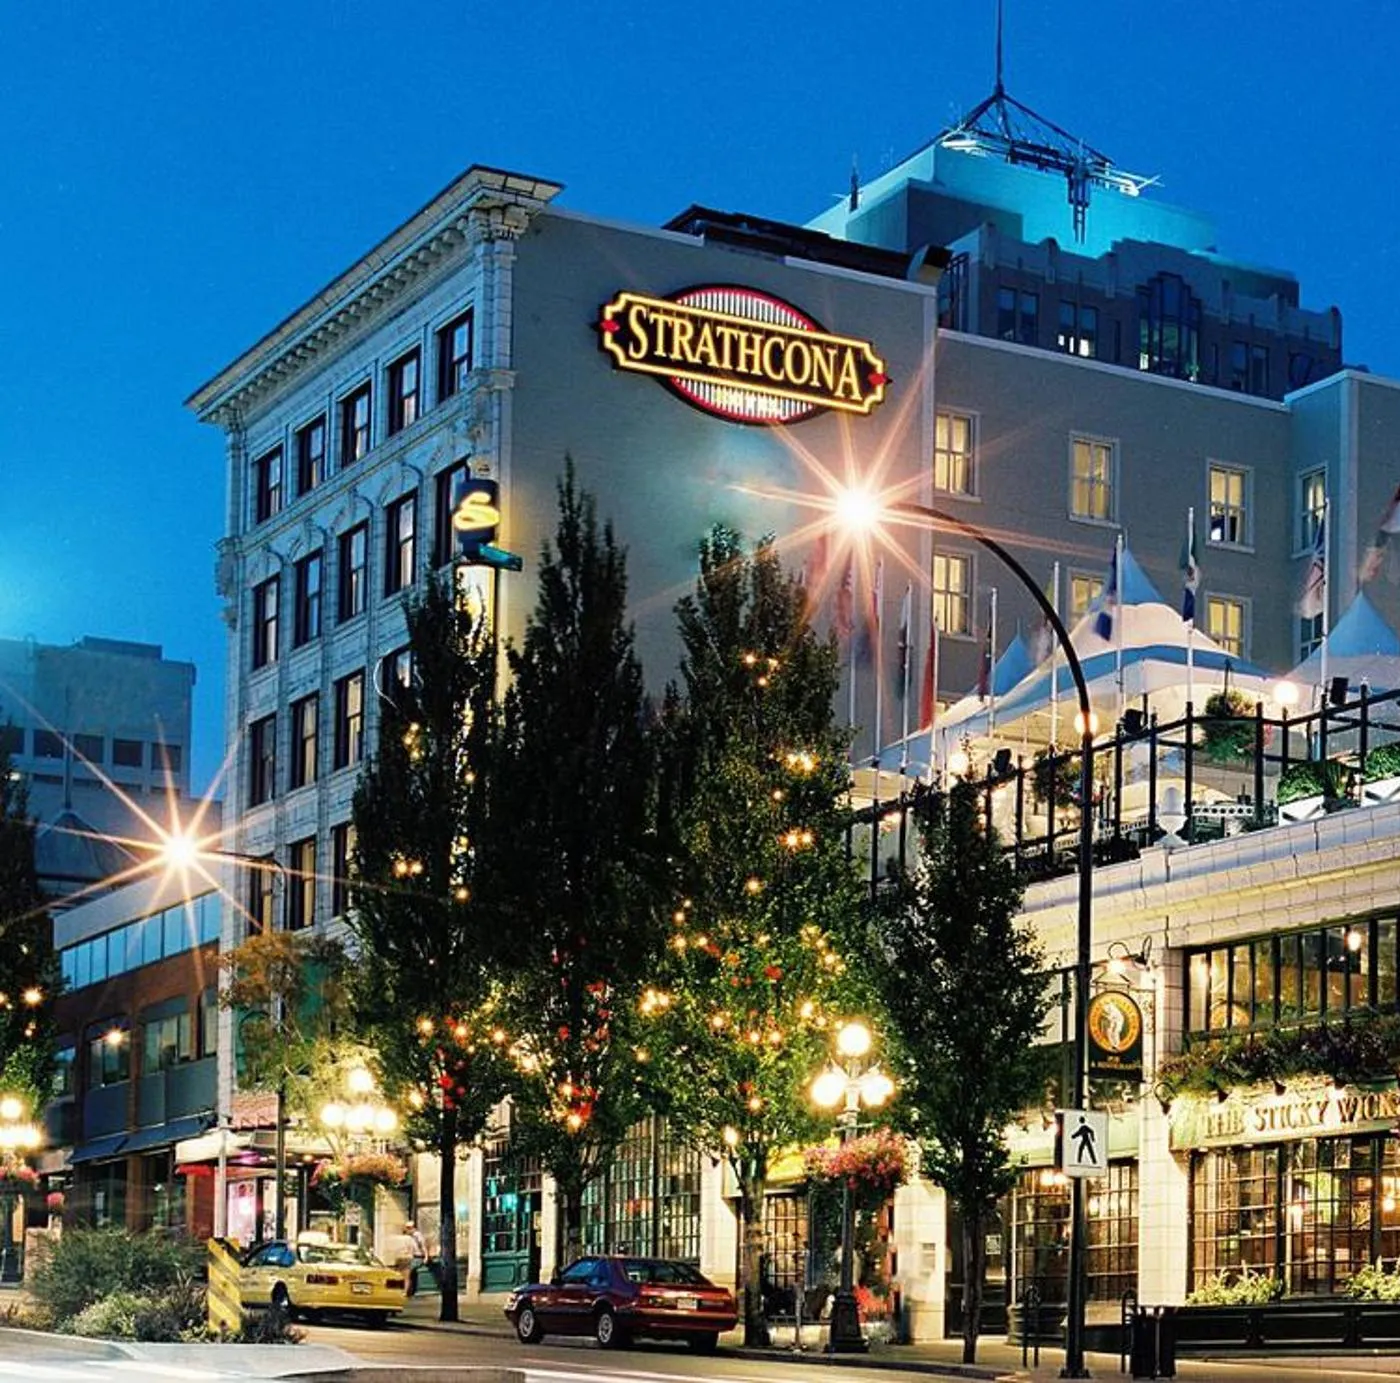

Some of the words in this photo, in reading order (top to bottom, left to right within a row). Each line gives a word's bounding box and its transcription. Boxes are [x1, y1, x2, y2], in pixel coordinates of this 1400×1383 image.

[627, 304, 864, 402] STRATHCONA
[1203, 1107, 1245, 1138] THE
[1254, 1099, 1330, 1132] STICKY
